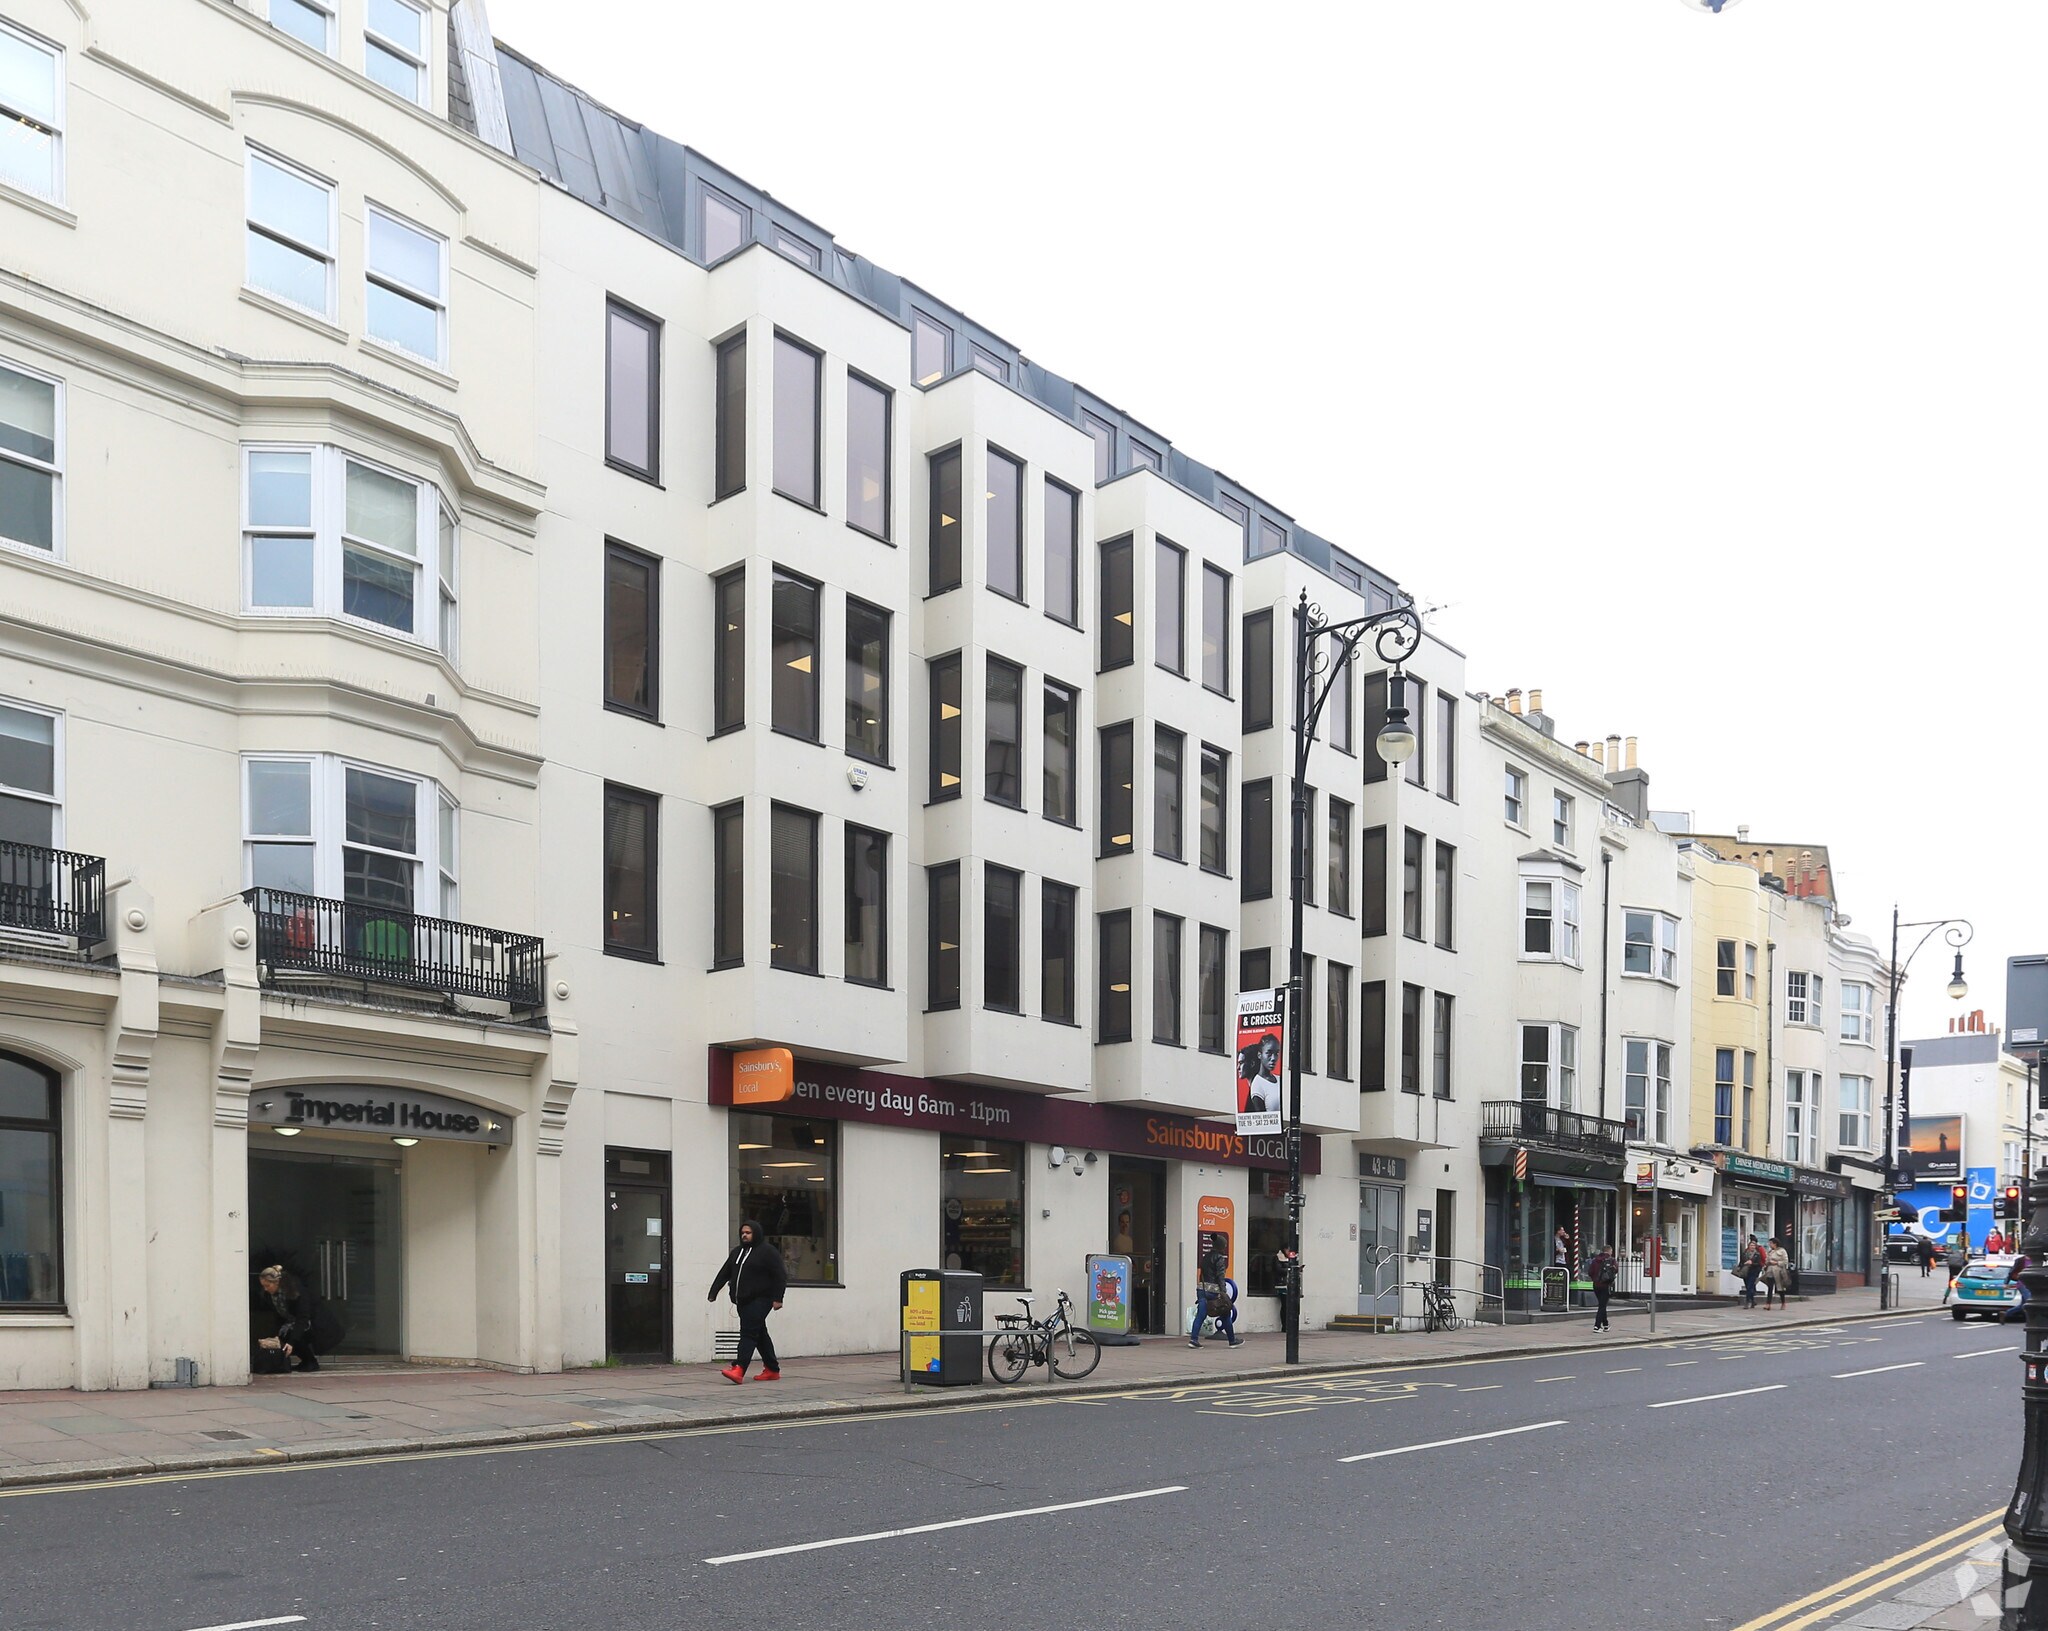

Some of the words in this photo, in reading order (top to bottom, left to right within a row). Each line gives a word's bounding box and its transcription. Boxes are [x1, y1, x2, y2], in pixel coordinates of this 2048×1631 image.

[1241, 1001, 1273, 1012] NOUGHTS
[1243, 1016, 1249, 1026] &
[1251, 1013, 1282, 1025] CROSSES
[738, 1060, 781, 1073] Sainsbury's
[739, 1081, 759, 1093] Local
[792, 1081, 820, 1099] en
[825, 1084, 876, 1112] every
[880, 1088, 914, 1116] day
[917, 1094, 955, 1116] 6am
[970, 1101, 1010, 1125] 11pm
[284, 1091, 395, 1126] Imperial
[401, 1102, 480, 1133] House
[1146, 1119, 1244, 1158] Sainsburys
[1248, 1131, 1289, 1159] Local
[1372, 1157, 1380, 1175] 43
[1735, 1157, 1752, 1168] CHINESE
[1752, 1160, 1771, 1171] MEDICINE
[1771, 1164, 1786, 1174] CENTRE
[1799, 1175, 1809, 1185] AFRO
[1819, 1179, 1837, 1190] ACADEMY
[1203, 1204, 1228, 1214] Sainsbury's
[1121, 1390, 1367, 1408] STOP
